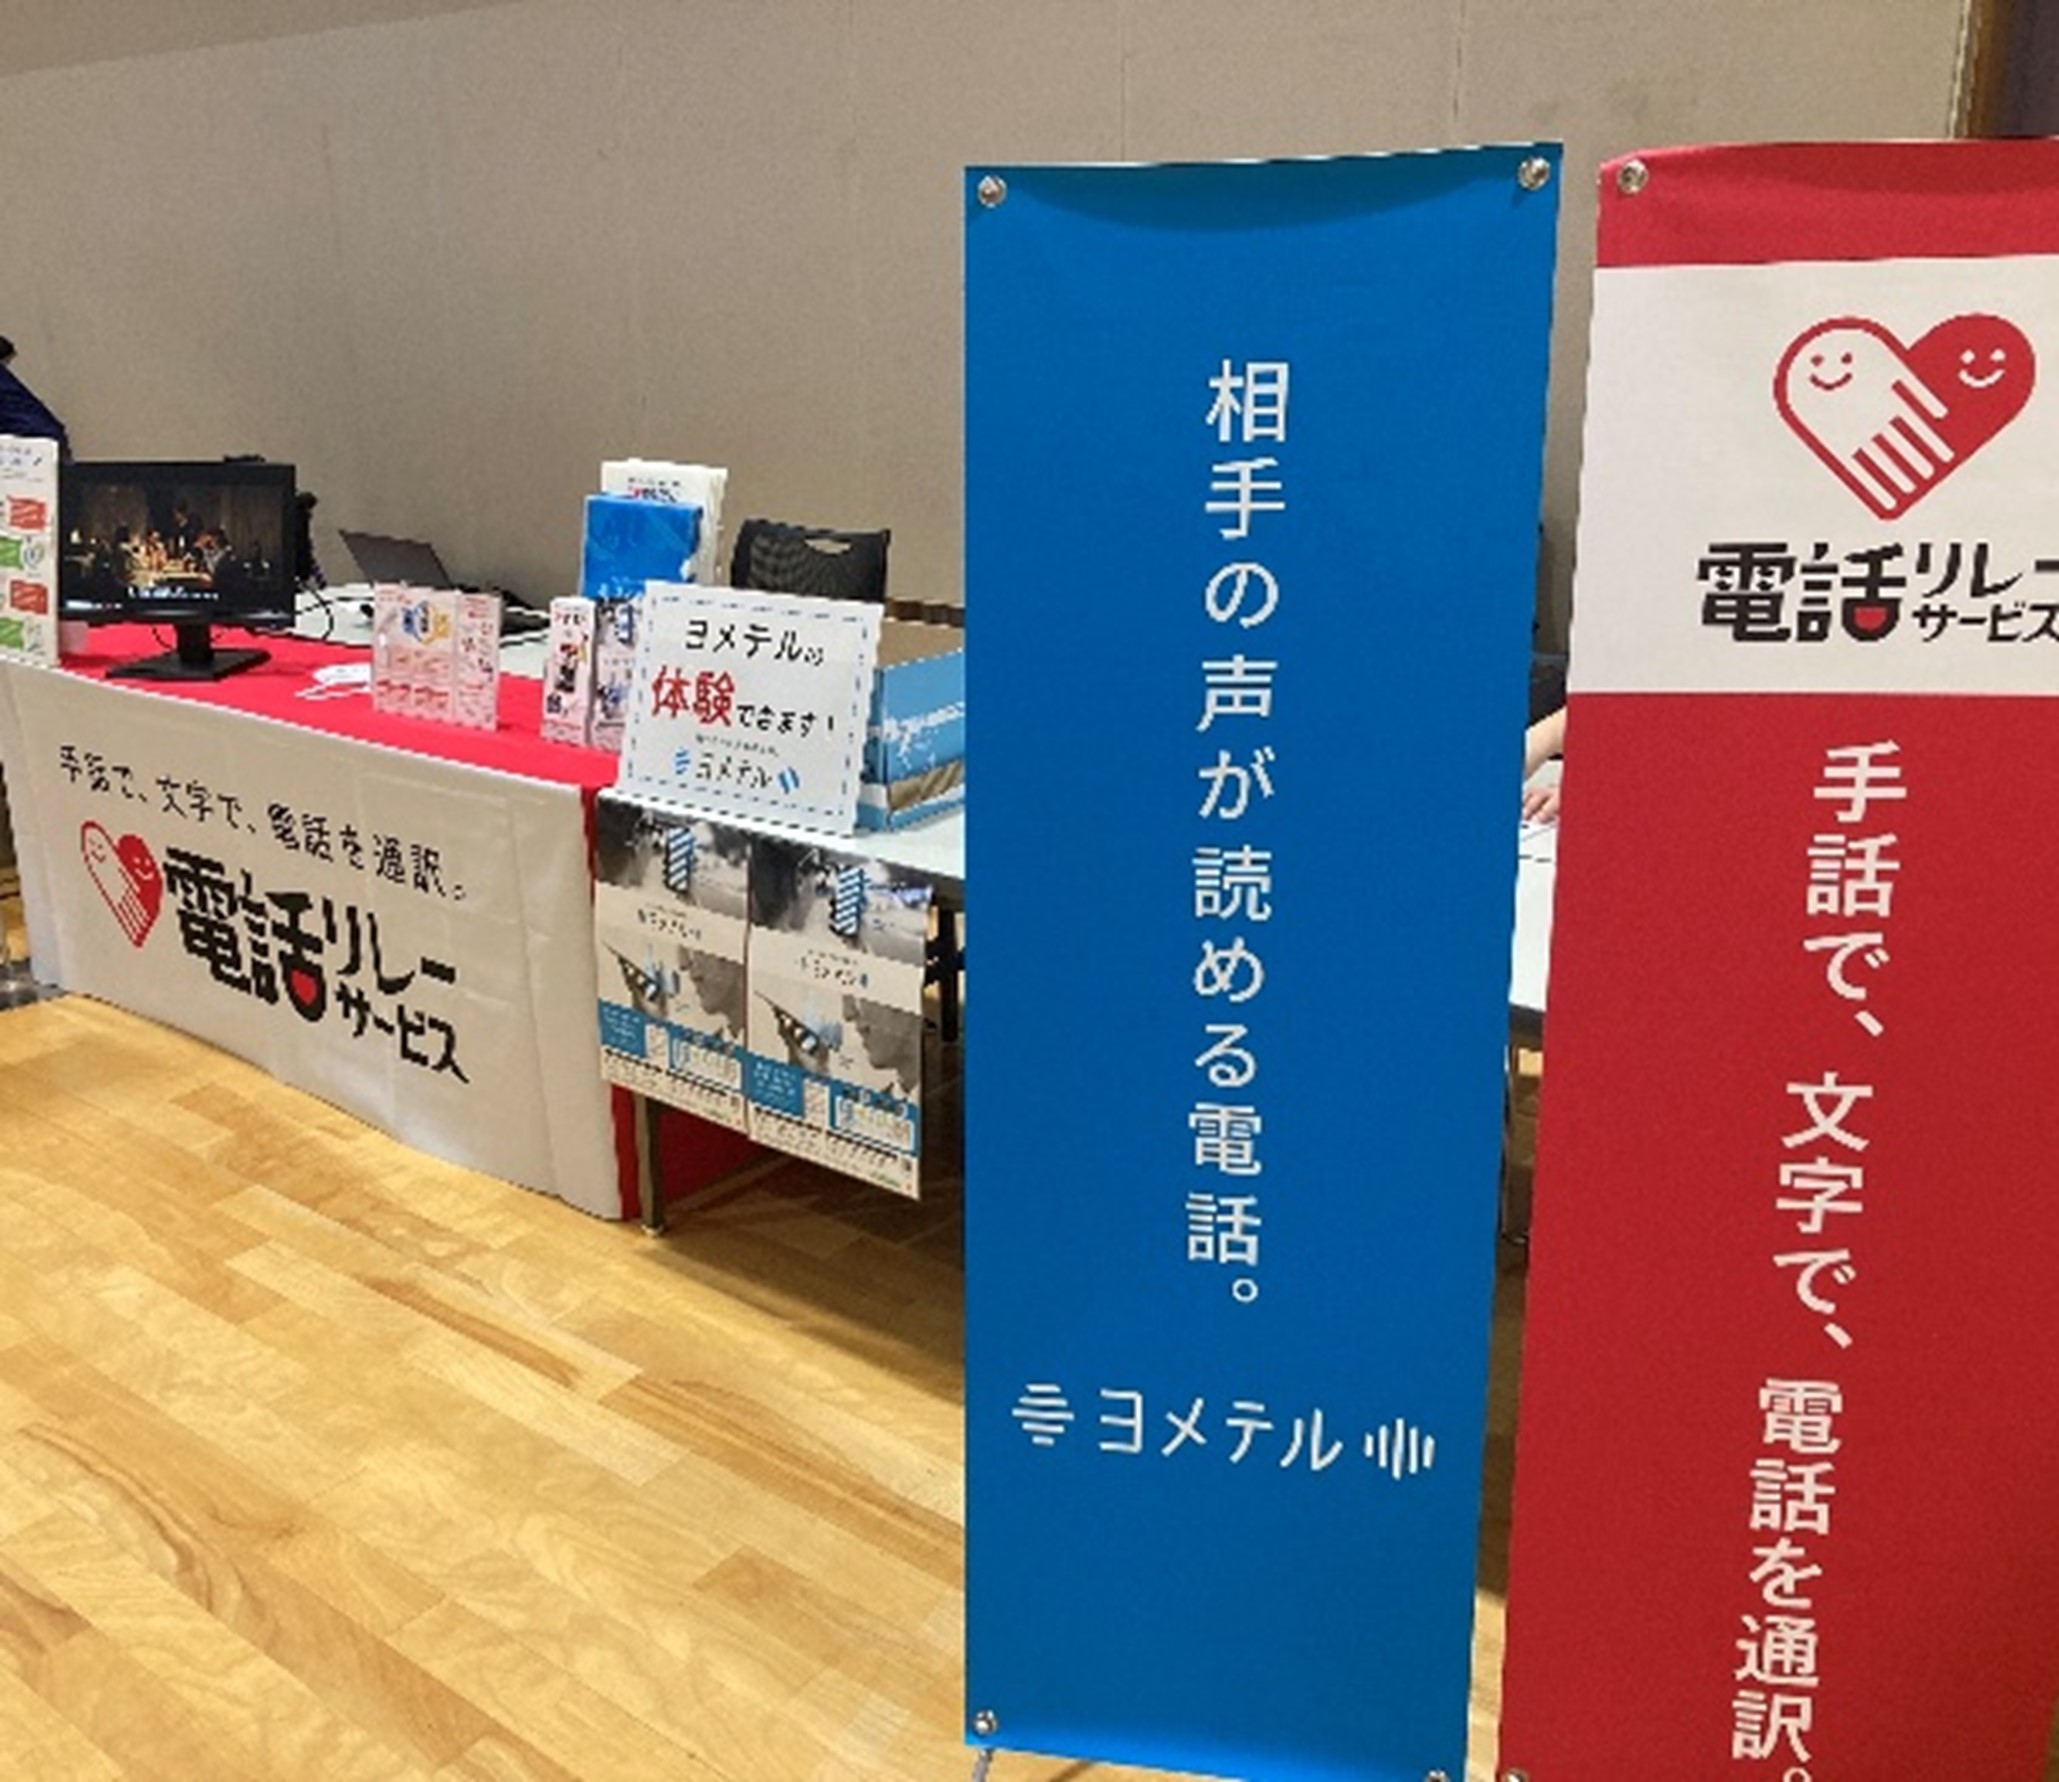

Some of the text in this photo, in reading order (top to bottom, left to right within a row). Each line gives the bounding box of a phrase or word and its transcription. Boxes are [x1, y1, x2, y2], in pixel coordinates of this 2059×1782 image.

[1911, 601, 2059, 643] サービス
[1185, 358, 1290, 1303] 相手の声が読める電話。
[335, 981, 470, 1085] サービス
[1098, 1387, 1344, 1472] ヨメテル
